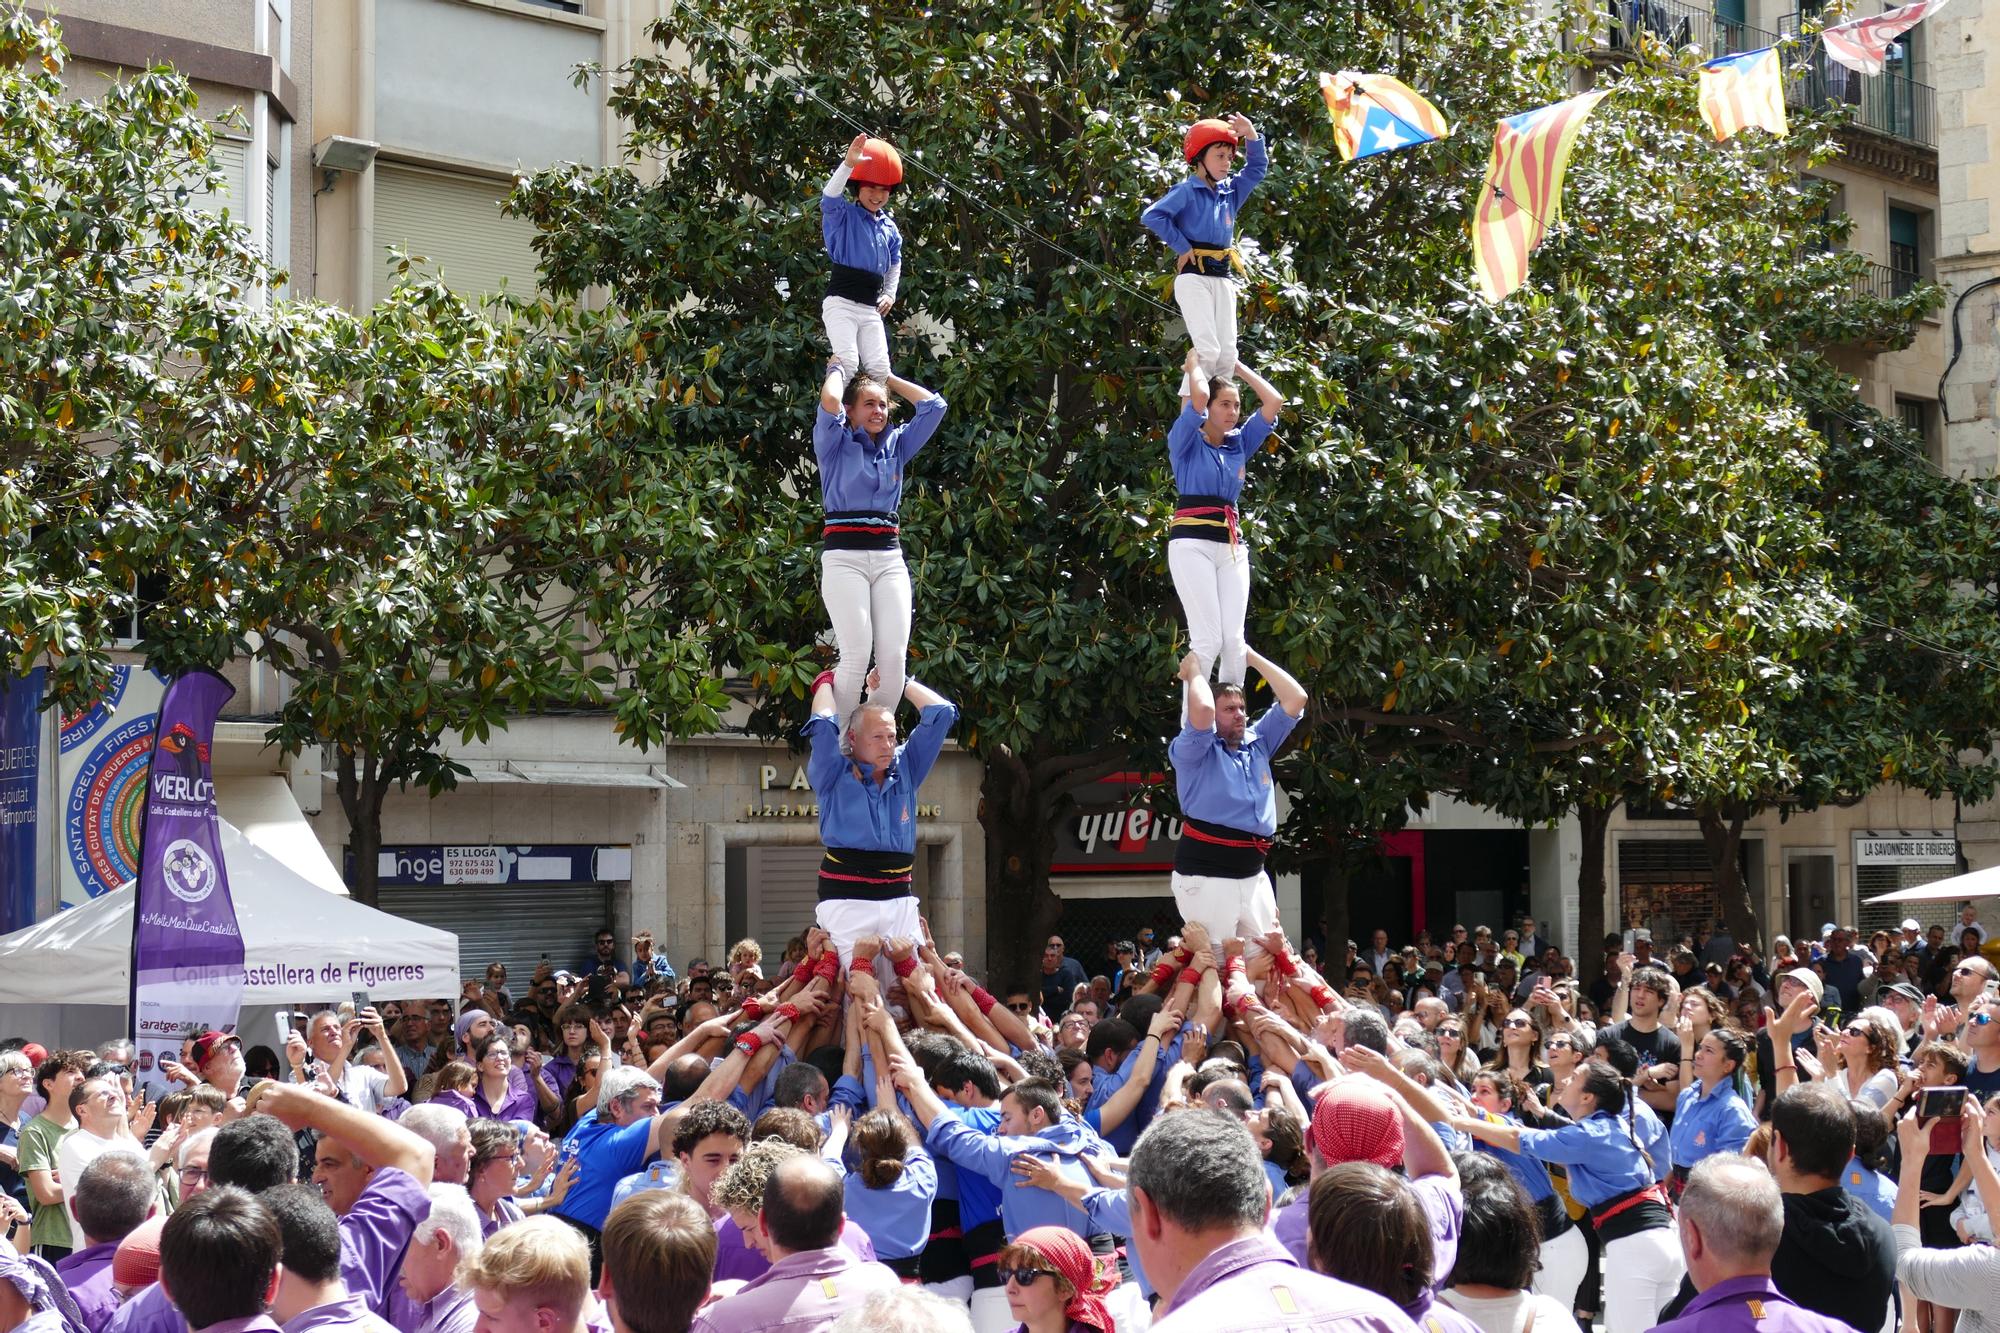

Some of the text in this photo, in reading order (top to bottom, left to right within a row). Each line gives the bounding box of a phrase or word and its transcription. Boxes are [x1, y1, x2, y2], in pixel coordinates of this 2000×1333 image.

[104, 721, 149, 753] FIRES
[98, 743, 142, 789] FIGUERES
[72, 763, 97, 812] CREU
[91, 789, 103, 805] DE
[193, 809, 201, 818] de
[88, 807, 100, 850] CIUTAT
[687, 833, 700, 845] 22
[71, 815, 91, 874] SANTA
[447, 848, 497, 858] ES LLOGA
[1864, 842, 1956, 857] LA SAVONNERIE DE FIGUERES
[97, 858, 120, 887] ERES
[397, 858, 443, 882] nge
[449, 868, 494, 876] 630 609 499
[225, 962, 315, 987] Castellera
[321, 962, 342, 984] de
[348, 961, 425, 988] Figueres
